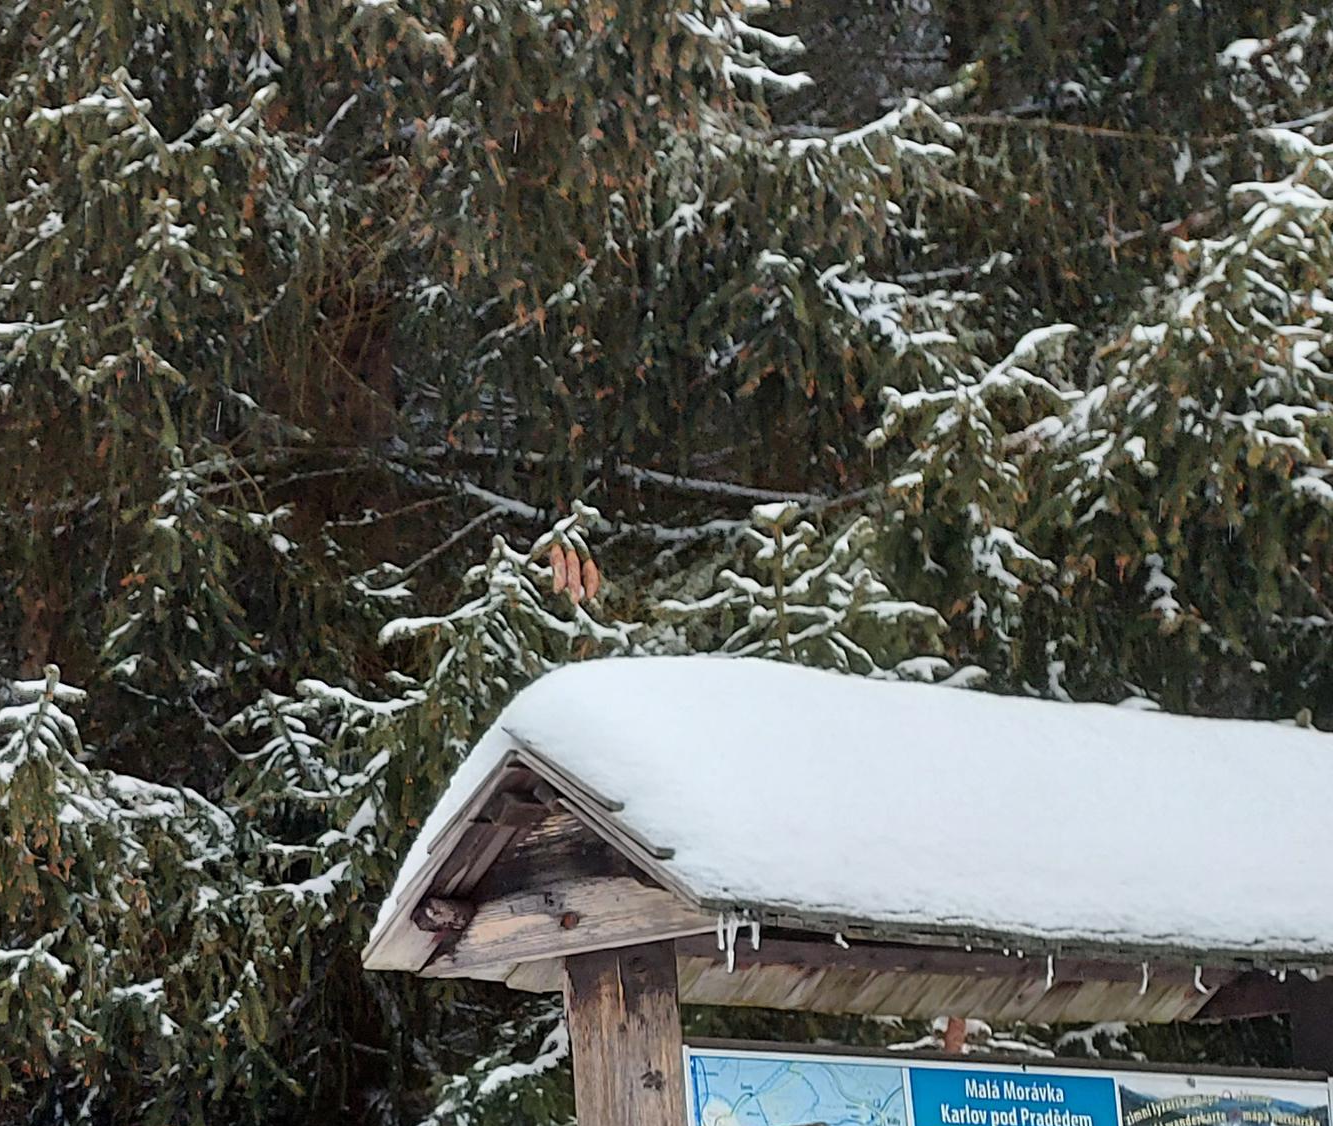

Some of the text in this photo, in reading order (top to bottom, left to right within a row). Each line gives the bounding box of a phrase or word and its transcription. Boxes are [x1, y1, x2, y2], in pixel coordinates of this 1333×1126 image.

[965, 1078, 1064, 1103] Malá Morávka
[941, 1103, 987, 1125] Karlov
